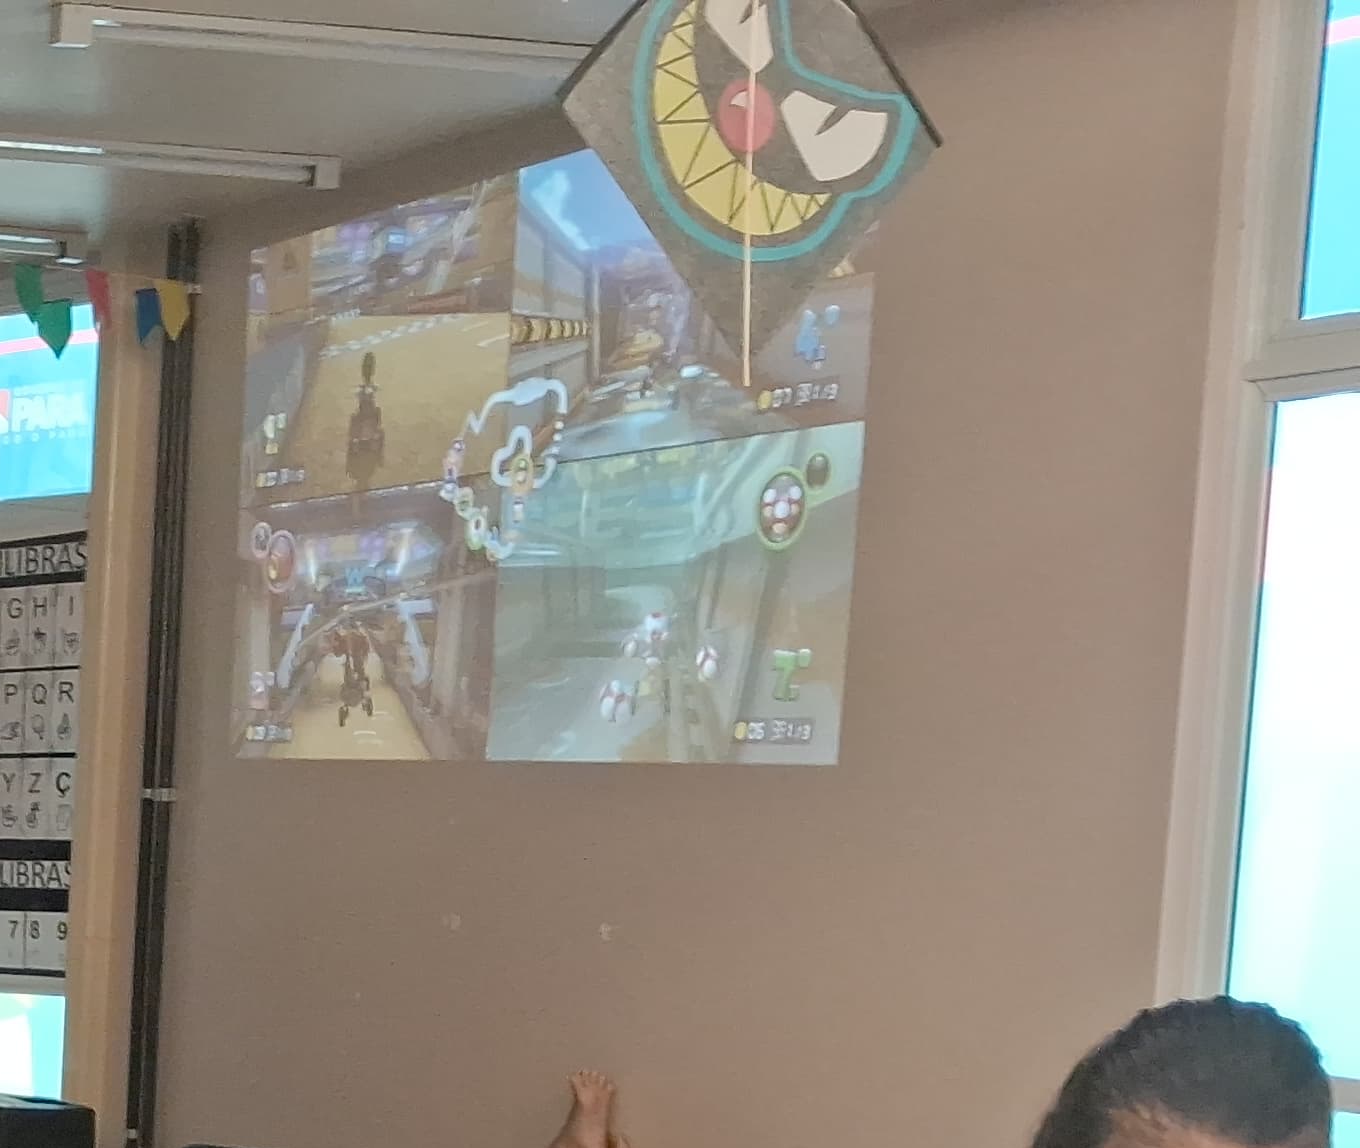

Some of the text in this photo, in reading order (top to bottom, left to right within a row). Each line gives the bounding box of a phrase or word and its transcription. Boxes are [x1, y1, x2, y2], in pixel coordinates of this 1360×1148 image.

[4, 541, 87, 576] LIBRAS
[7, 598, 23, 619] G
[33, 596, 48, 616] H
[4, 684, 18, 704] P
[32, 683, 48, 705] Q
[59, 681, 74, 703] R
[0, 772, 16, 792] Y
[28, 772, 42, 794] Z
[55, 772, 72, 799] Ç
[8, 920, 19, 938] 7
[30, 920, 40, 939] 8
[56, 921, 68, 940] 9
